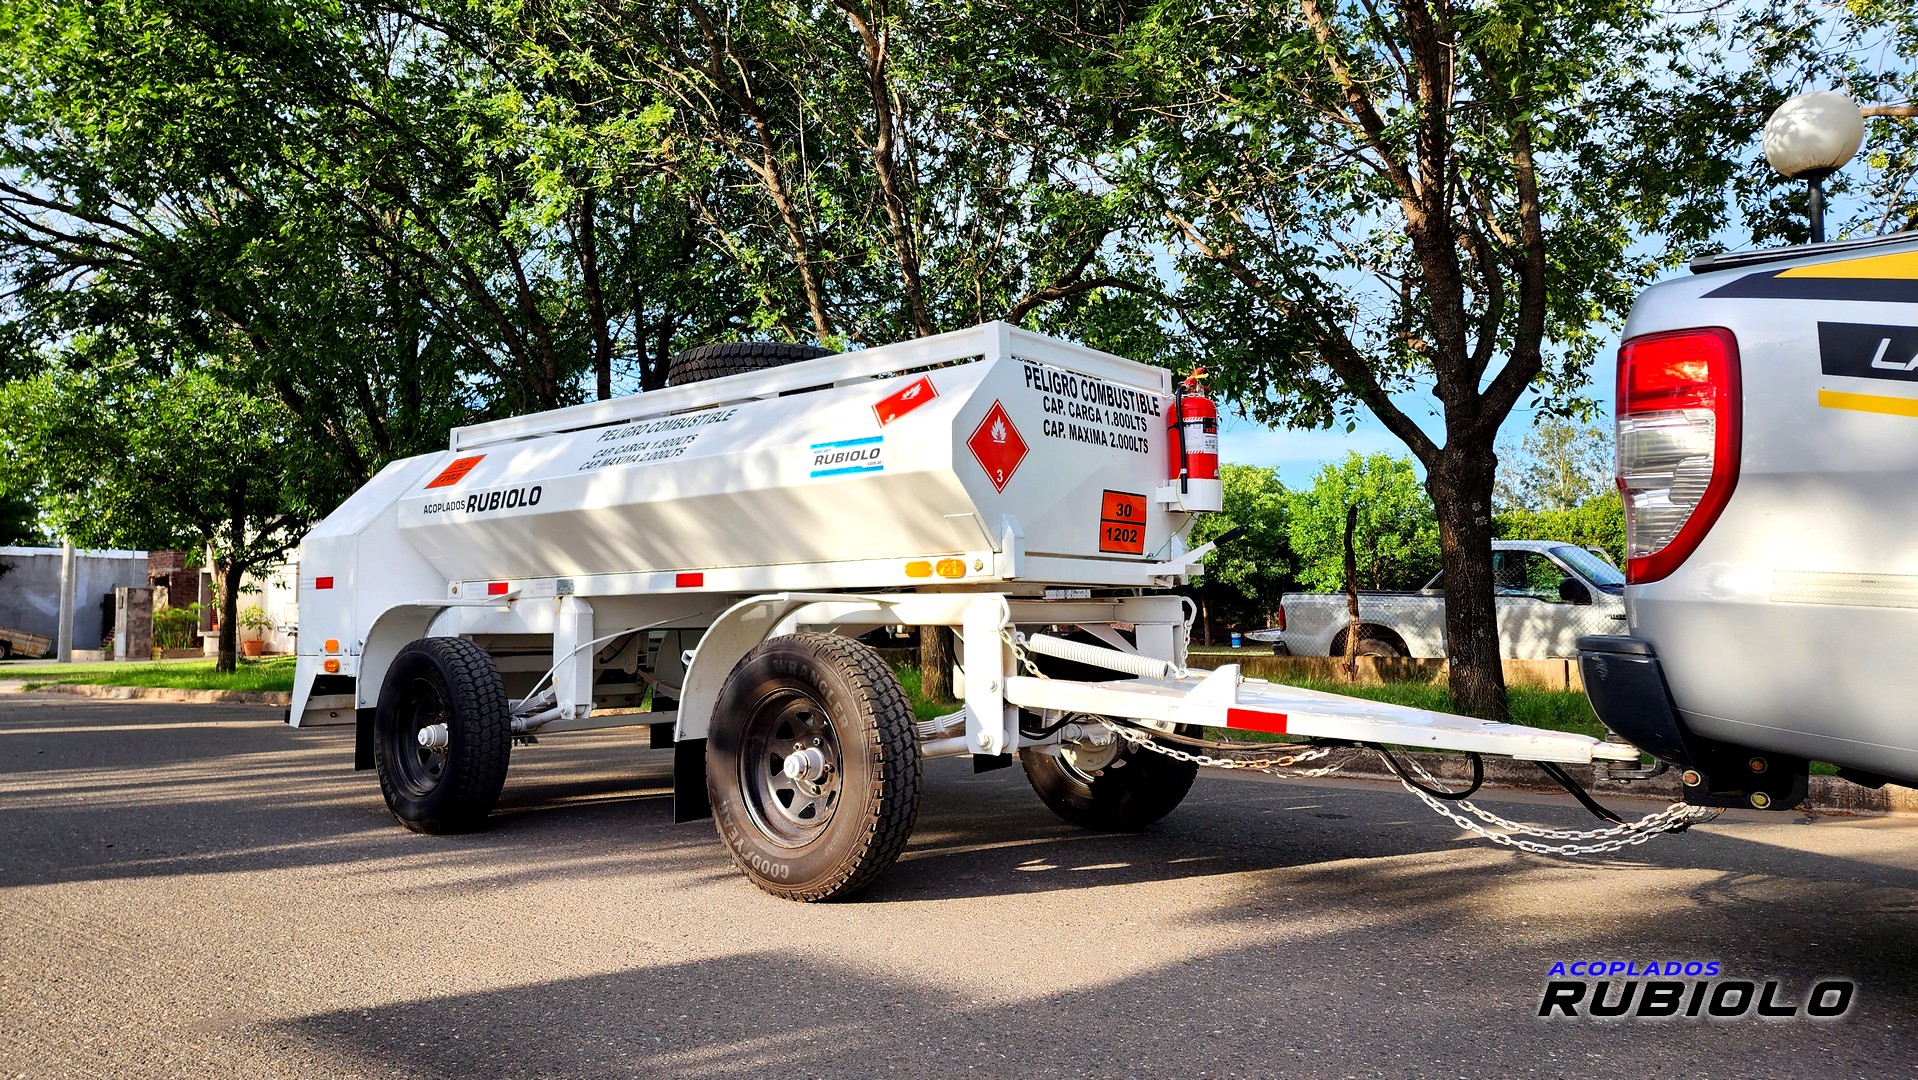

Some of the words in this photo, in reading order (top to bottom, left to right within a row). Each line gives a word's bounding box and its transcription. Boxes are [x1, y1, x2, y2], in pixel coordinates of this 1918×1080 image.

[1024, 365, 1078, 399] PELIGRO
[1081, 379, 1161, 417] COMBUSTIBLE
[596, 423, 650, 442] PELIGRO
[646, 409, 738, 434] COMBUSTIBLE
[1043, 396, 1066, 415] CAP.
[1068, 402, 1102, 424] CARGA
[1105, 410, 1147, 432] 1.800LTS
[614, 441, 650, 455] CARGA
[650, 434, 699, 449] 1.800LTS
[1043, 419, 1066, 439] CAP.
[1069, 424, 1108, 447] MAXIMA
[1109, 432, 1149, 454] 2.000LTS
[599, 452, 640, 468] MAXIMA
[638, 447, 687, 462] 2.000LTS
[814, 448, 881, 467] RUBIOLO
[996, 468, 1004, 483] 3
[423, 500, 466, 514] ACOPLADOS
[466, 485, 542, 513] RUBIOLO
[1115, 502, 1133, 518] 30
[1105, 527, 1138, 543] 1202
[772, 659, 849, 728] WRANGLER
[718, 799, 790, 880] GOODYEAR
